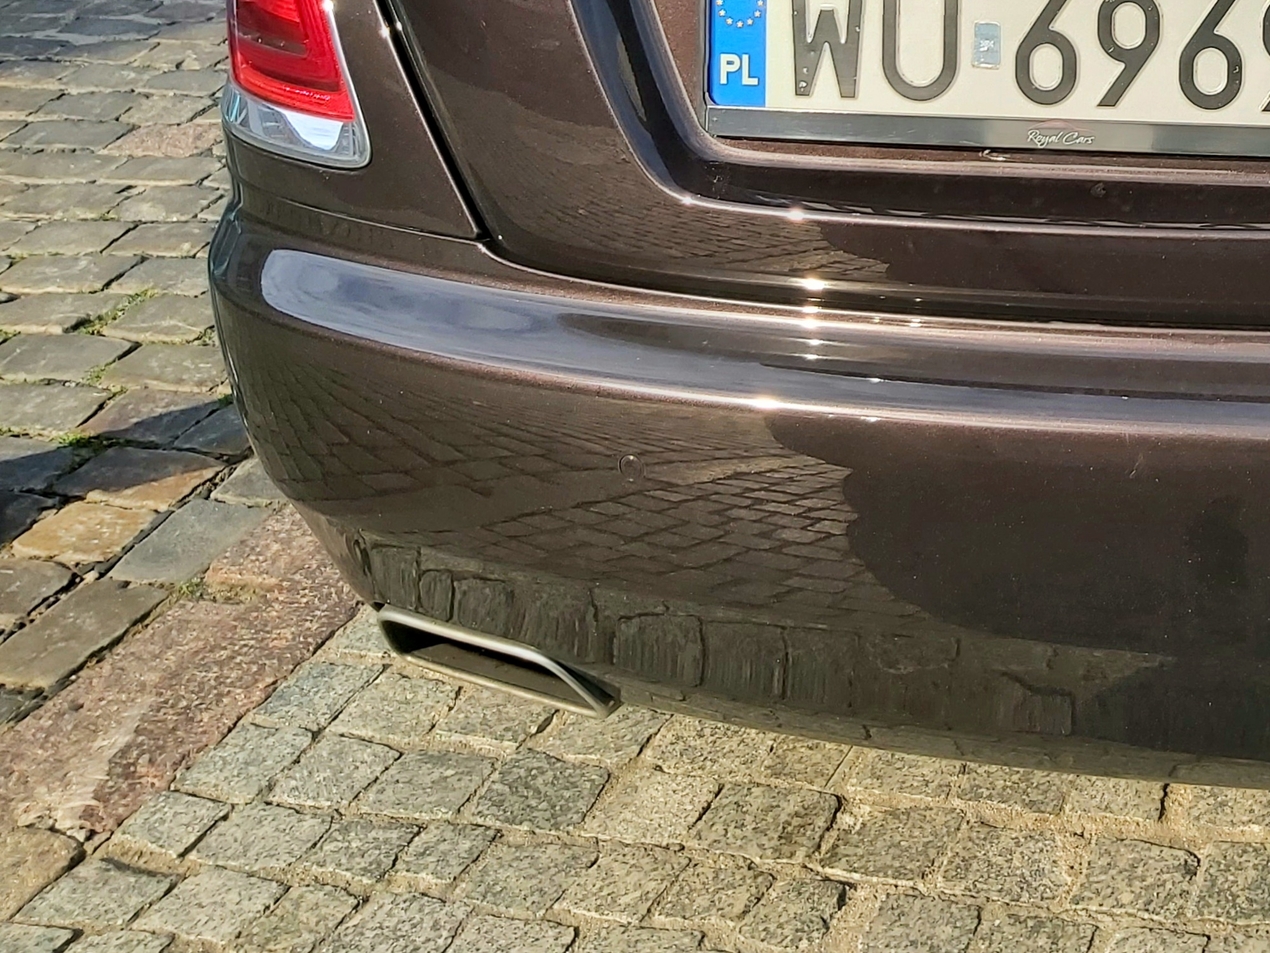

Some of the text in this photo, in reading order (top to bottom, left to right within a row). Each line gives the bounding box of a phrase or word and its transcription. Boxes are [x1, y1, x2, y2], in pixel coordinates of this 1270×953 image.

[719, 53, 759, 86] PL
[1027, 129, 1095, 148] Royal Cars
